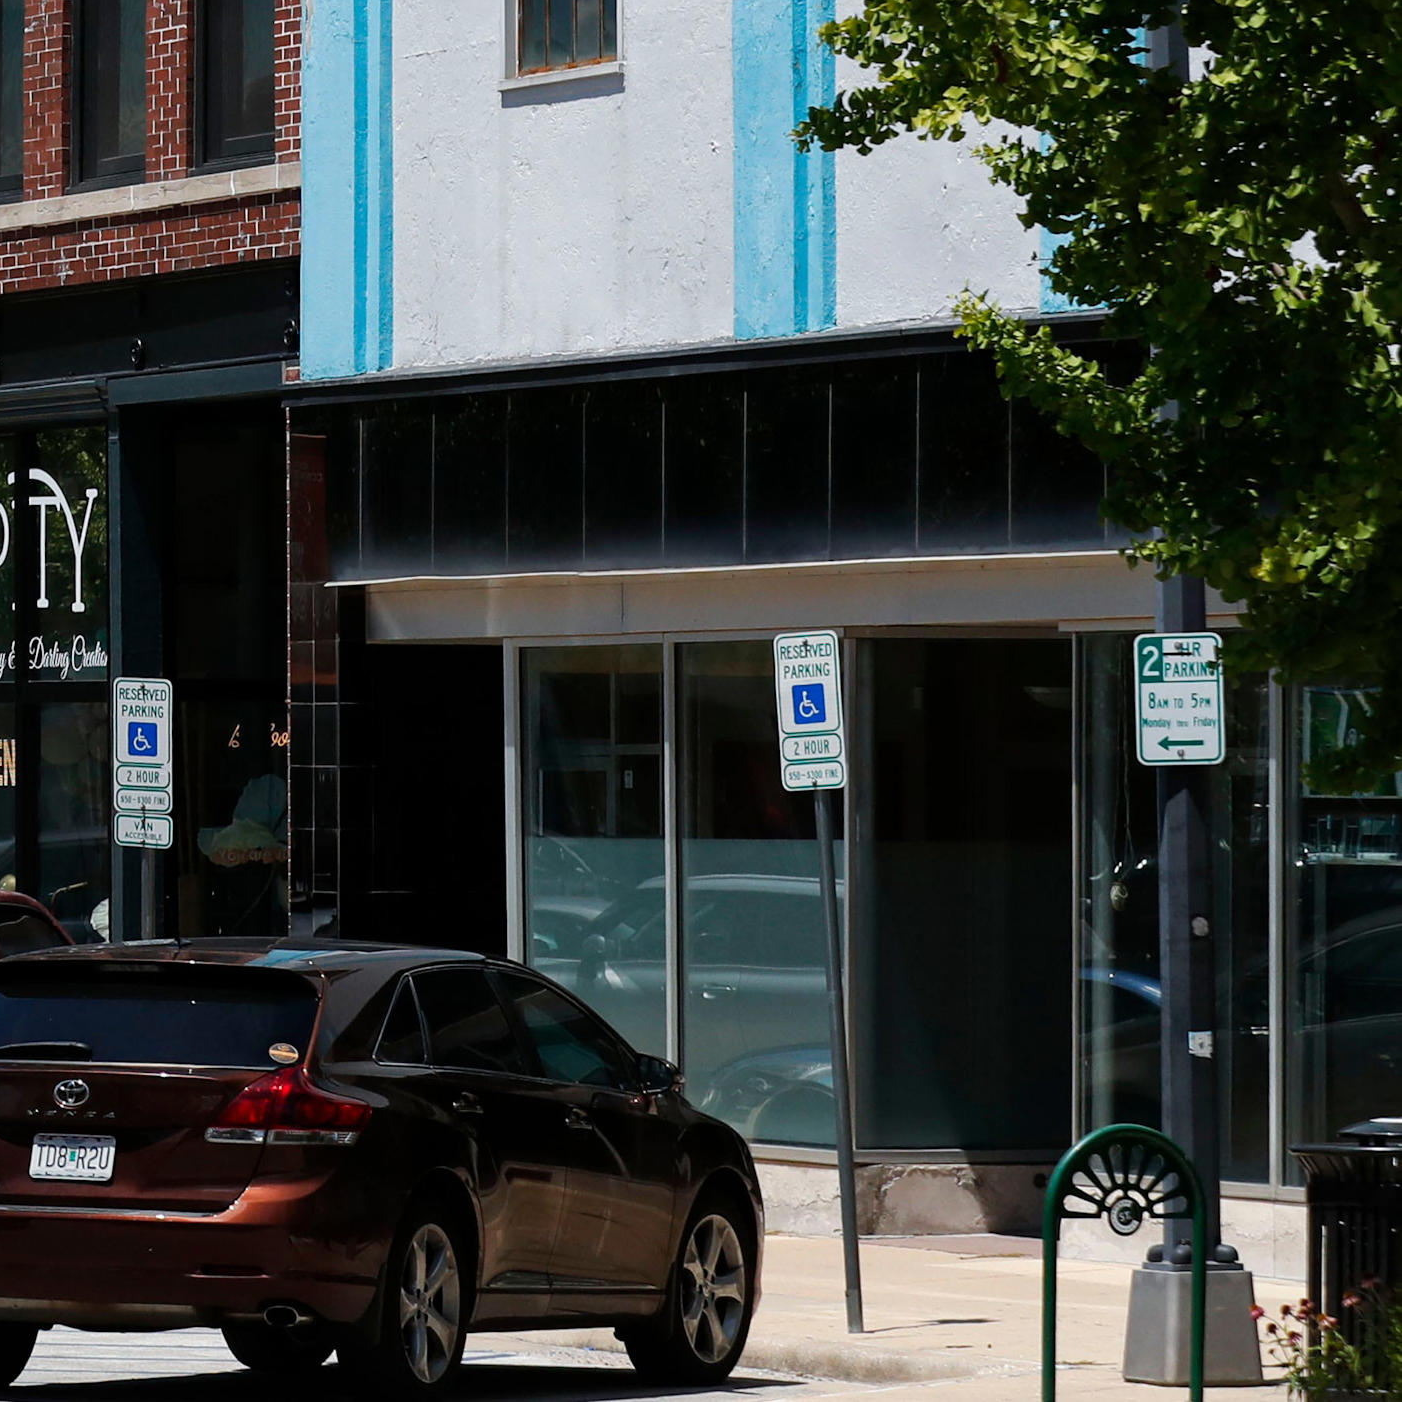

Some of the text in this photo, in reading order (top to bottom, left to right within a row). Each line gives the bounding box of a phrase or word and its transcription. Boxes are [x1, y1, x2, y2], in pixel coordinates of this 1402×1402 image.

[29, 636, 70, 680] Darling
[780, 643, 832, 660] RESERVED
[1142, 642, 1201, 677] 2 HR
[783, 662, 830, 679] PARKING
[1164, 661, 1215, 678] PARKIN
[119, 688, 167, 701] RESERVED
[121, 704, 164, 718] PARKING
[1142, 718, 1171, 729] Monday
[1193, 716, 1216, 728] Friday
[794, 739, 830, 756] 2 HOUR
[127, 771, 160, 784] 2 HOUR
[825, 768, 839, 779] FINE
[153, 796, 166, 806] FINE
[134, 820, 154, 832] VAN
[125, 831, 163, 842] ACCESSIBLE
